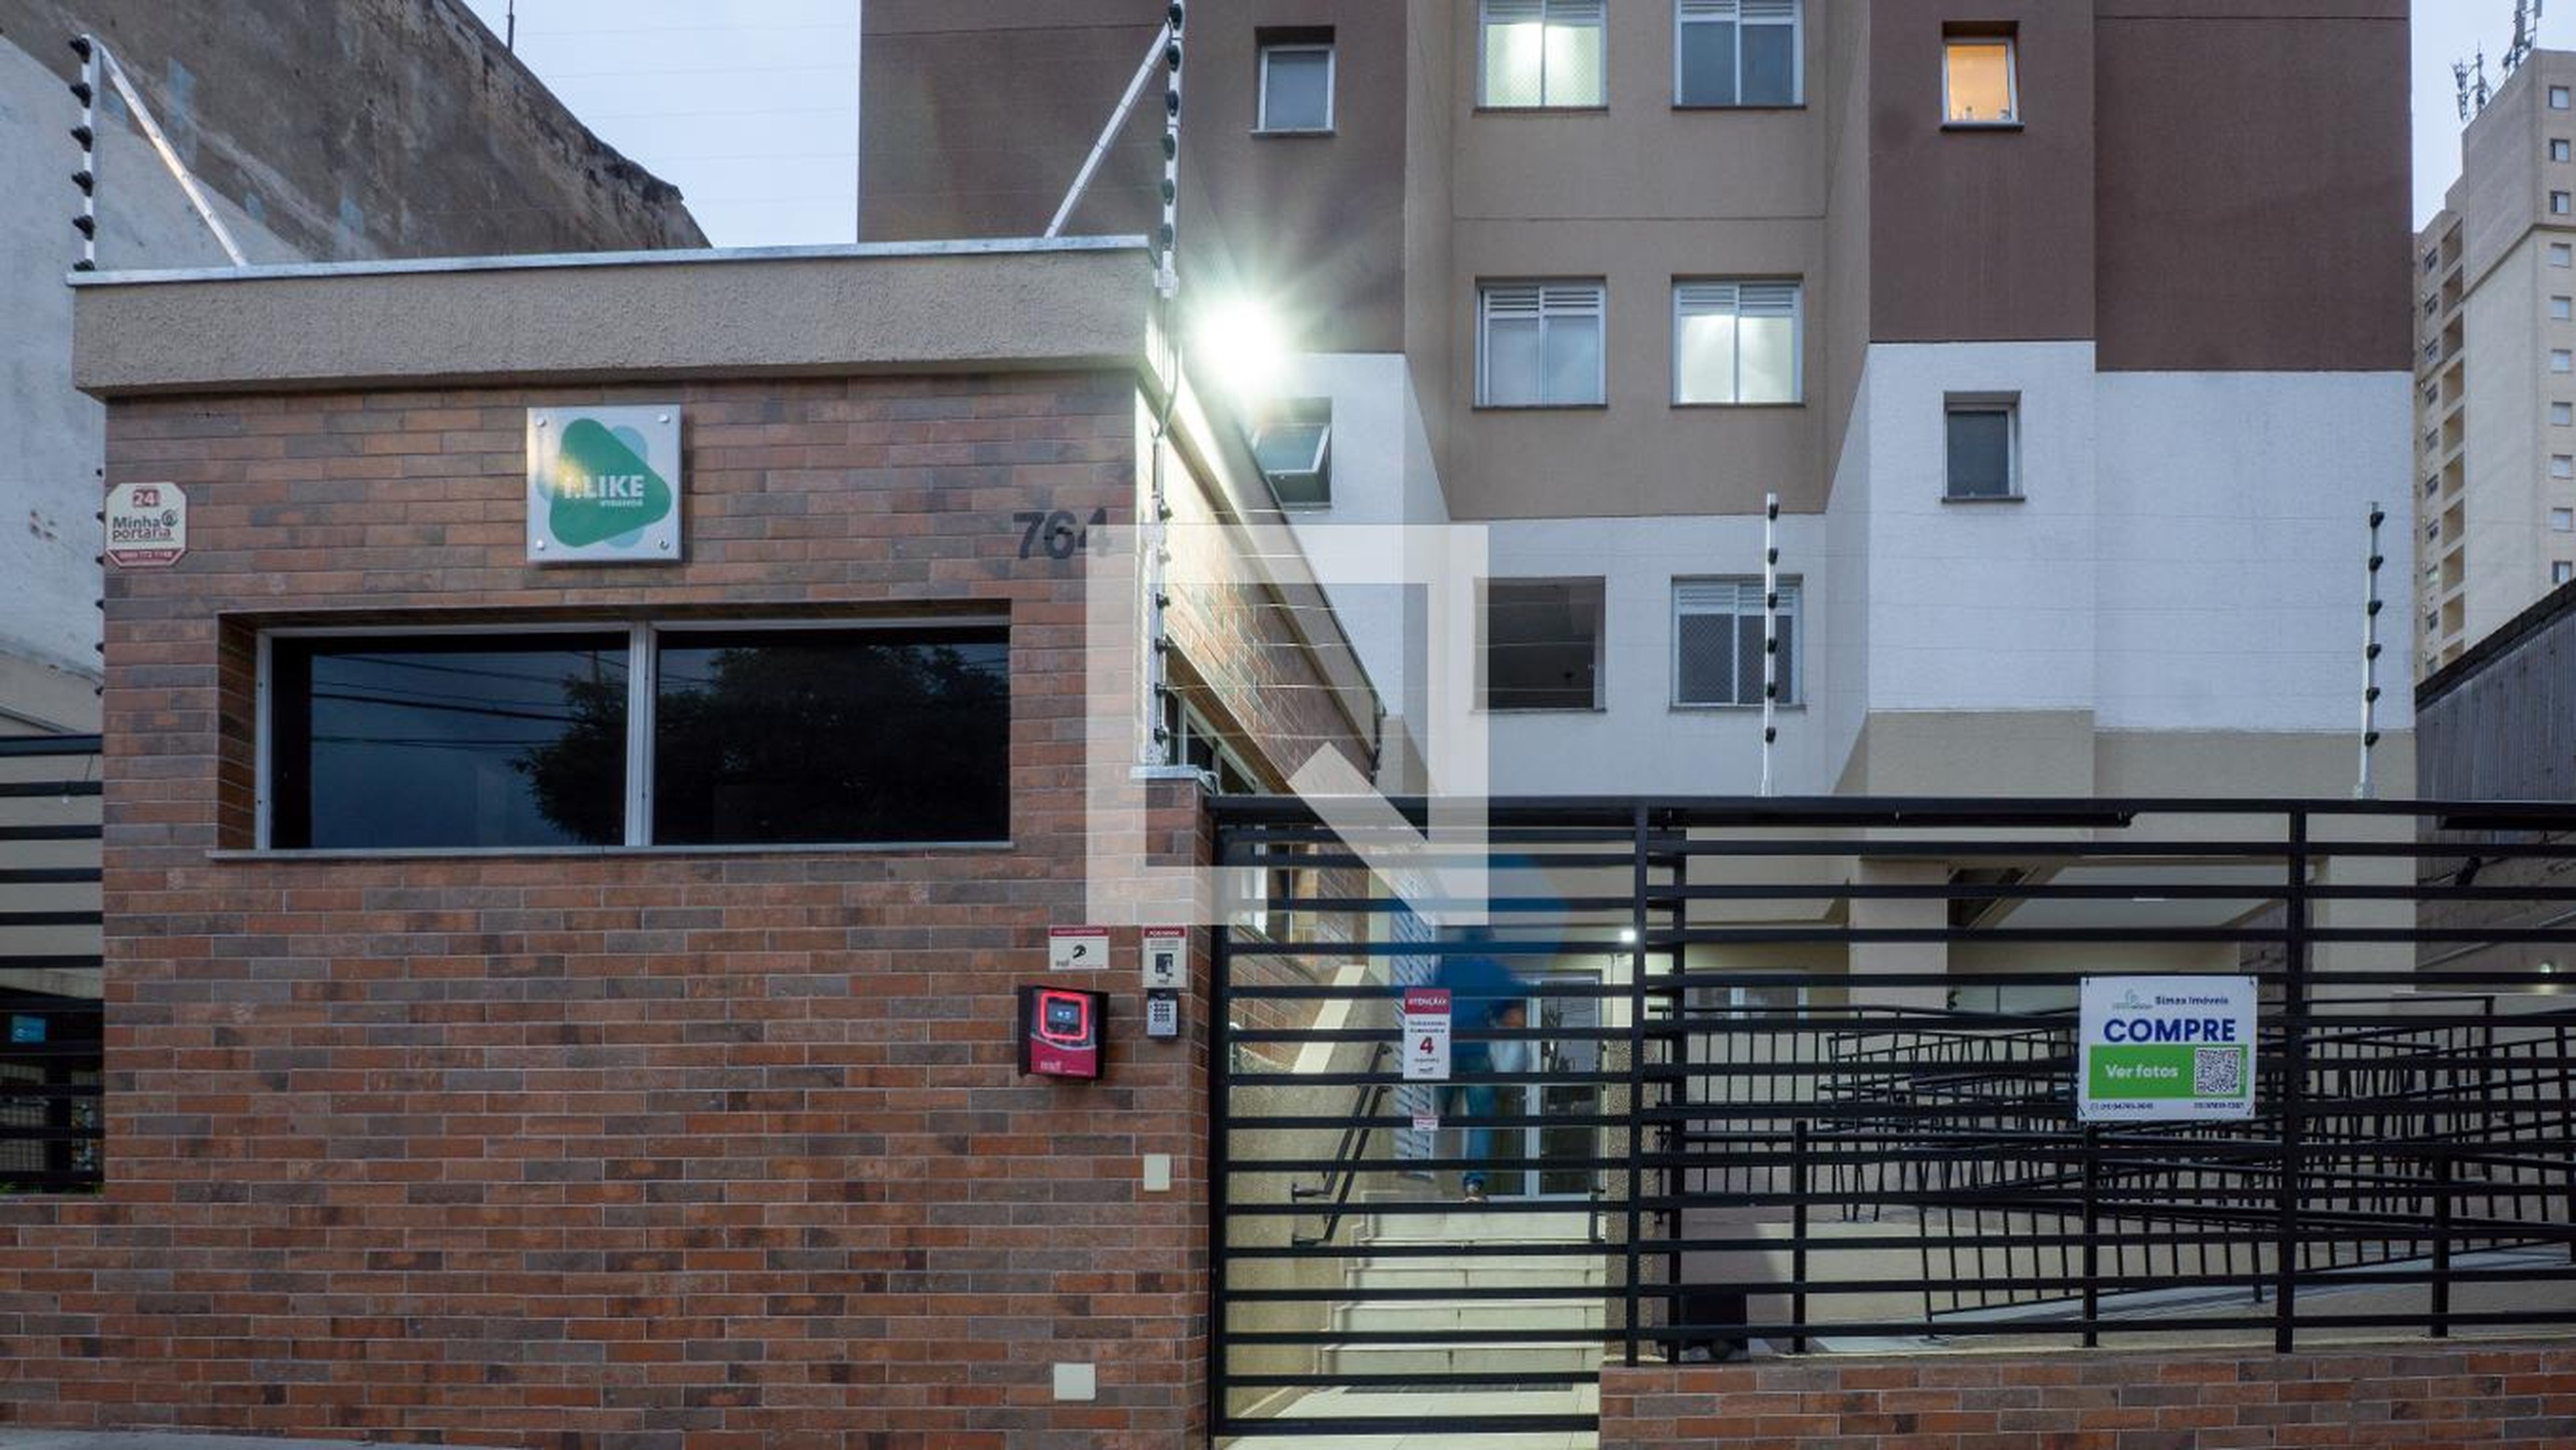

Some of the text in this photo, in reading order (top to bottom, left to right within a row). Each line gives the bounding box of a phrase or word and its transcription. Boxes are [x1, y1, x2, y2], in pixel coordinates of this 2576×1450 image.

[113, 516, 160, 528] Minha
[113, 528, 171, 540] portaria
[2190, 995, 2229, 1005] Imóveis
[2104, 1019, 2236, 1042] COMPRE
[1419, 1036, 1434, 1055] 4
[2105, 1064, 2179, 1078] Ver fotos
